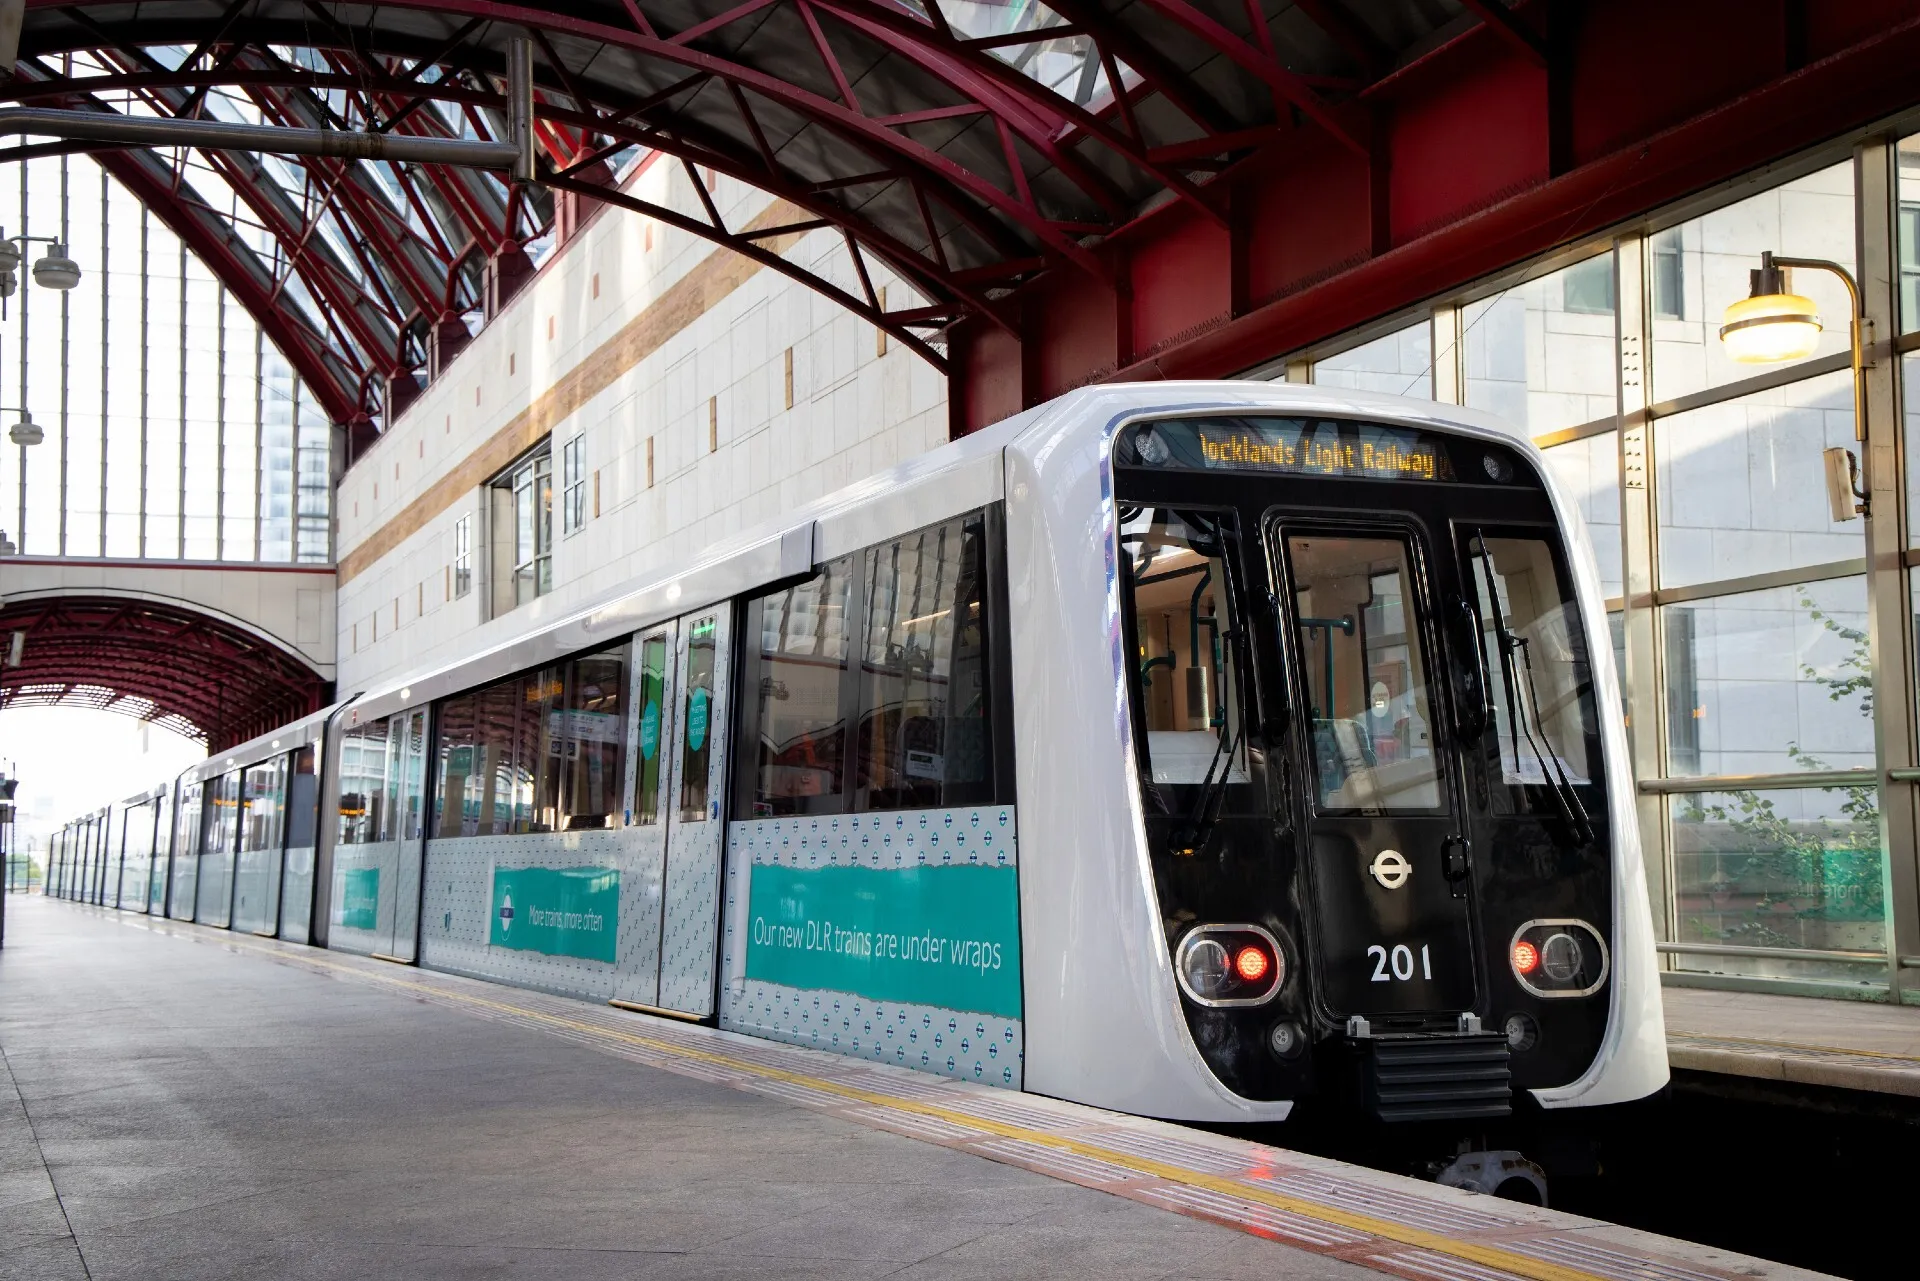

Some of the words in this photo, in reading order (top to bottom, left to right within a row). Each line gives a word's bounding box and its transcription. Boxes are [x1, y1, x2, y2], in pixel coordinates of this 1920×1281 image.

[1304, 439, 1354, 472] Light
[1363, 443, 1434, 479] Railway
[528, 904, 545, 926] More
[563, 912, 583, 930] more
[583, 907, 603, 931] often
[754, 916, 776, 946] Our
[778, 924, 804, 949] new
[806, 920, 832, 952] DLR
[835, 925, 872, 957] trains
[875, 932, 898, 959] are
[901, 928, 947, 963] under
[950, 938, 1002, 977] wraps
[1367, 943, 1432, 981] 201
